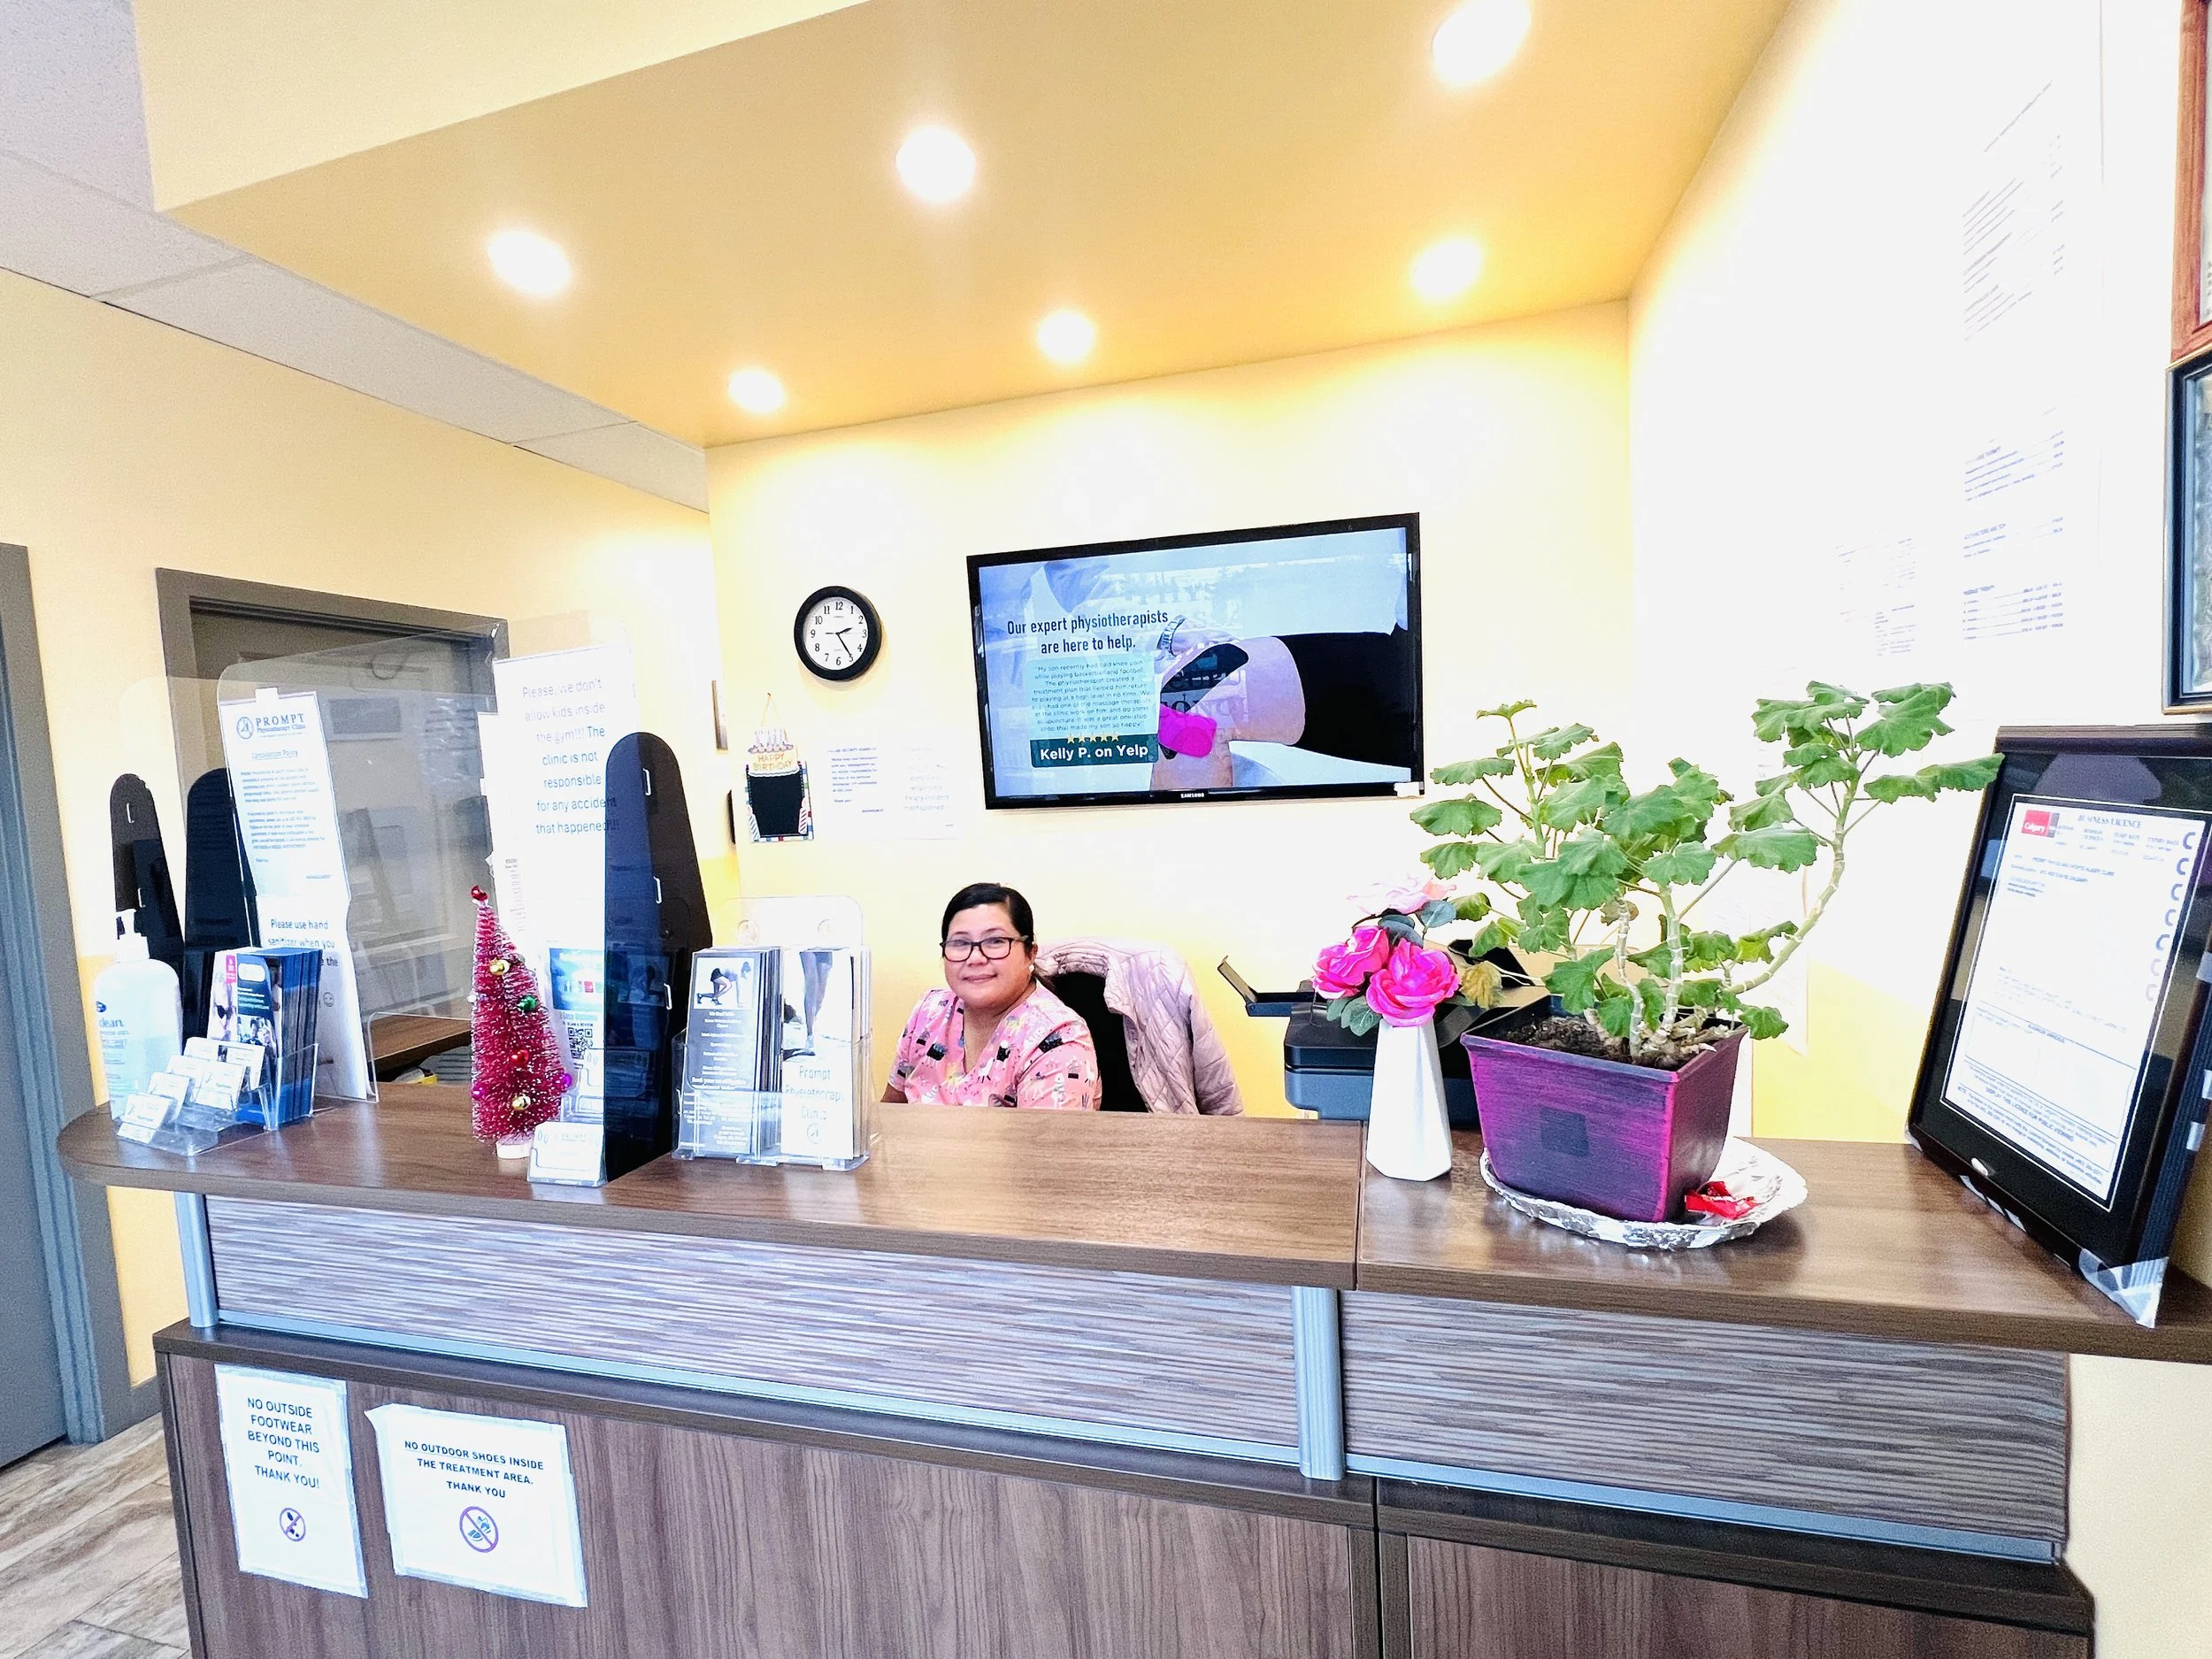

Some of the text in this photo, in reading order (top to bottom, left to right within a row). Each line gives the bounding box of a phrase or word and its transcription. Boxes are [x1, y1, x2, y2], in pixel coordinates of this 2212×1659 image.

[824, 605, 830, 615] 11
[835, 602, 844, 611] 12
[850, 605, 854, 614] 1
[815, 616, 823, 625] 10
[858, 615, 864, 625] 2
[1007, 610, 1169, 635] Our expert physiotherapists
[810, 629, 816, 638] 9
[862, 629, 867, 639] 3
[814, 643, 820, 652] 8
[857, 643, 863, 652] 4
[1041, 634, 1136, 655] are here to help.
[825, 653, 829, 662] 7
[836, 657, 841, 665] 6
[849, 654, 854, 663] 5
[522, 678, 603, 698] Please, we don't
[1057, 678, 1103, 687] physiotherapist
[525, 702, 605, 722] allow kids inside
[256, 713, 304, 726] PROMPT
[536, 732, 552, 743] the
[587, 726, 605, 738] The
[542, 751, 598, 766] clinic is not
[757, 753, 785, 762] HAPPY
[1040, 744, 1148, 761] Kelly P. on Yelp
[753, 759, 793, 771] BIRTHDAY
[543, 773, 602, 790] responsible
[536, 796, 618, 813] for any accident
[2077, 814, 2142, 829] BUSINESS LICENCE
[536, 823, 556, 834] that
[271, 918, 328, 930] Please use hand
[268, 937, 335, 950] sanitizer when you
[326, 956, 339, 967] the
[799, 1065, 831, 1081] Prompt
[248, 1397, 313, 1418] NO OUTSIDE
[250, 1414, 312, 1435] FOOTWEAR
[248, 1430, 320, 1453] BEYOND THIS
[267, 1449, 303, 1468] POINT.
[404, 1440, 545, 1471] NO OUTDOOR SHOES INSIDE
[254, 1464, 319, 1489] THANK YOU!
[417, 1458, 534, 1485] THE TREATMENT AREA.
[446, 1480, 506, 1498] THANK YOU
